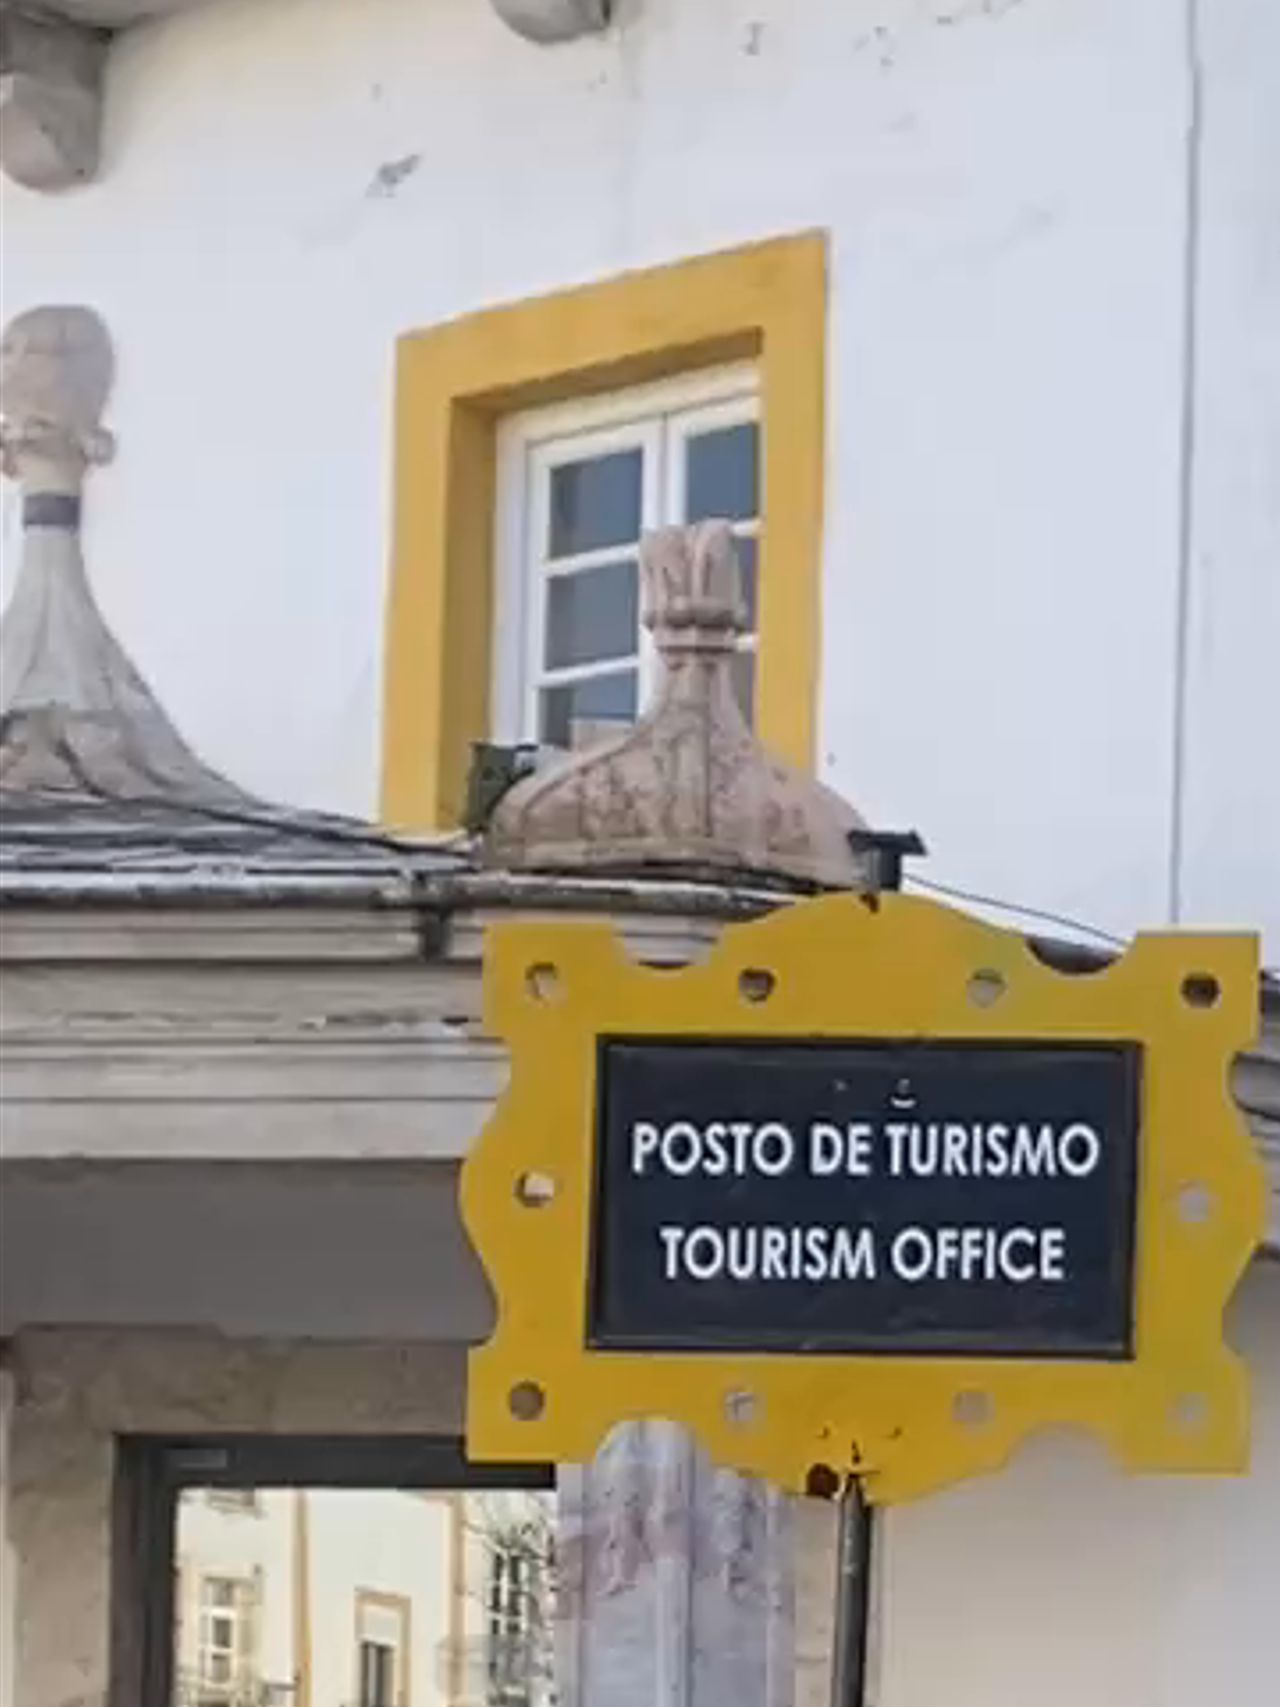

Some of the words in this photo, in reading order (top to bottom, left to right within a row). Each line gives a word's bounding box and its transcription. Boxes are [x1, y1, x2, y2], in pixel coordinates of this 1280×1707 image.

[632, 1123, 794, 1176] POSTO
[810, 1123, 871, 1175] DE
[884, 1123, 1099, 1177] TURISMO
[659, 1226, 876, 1280] TOURISM
[890, 1227, 1065, 1281] OFFICE
